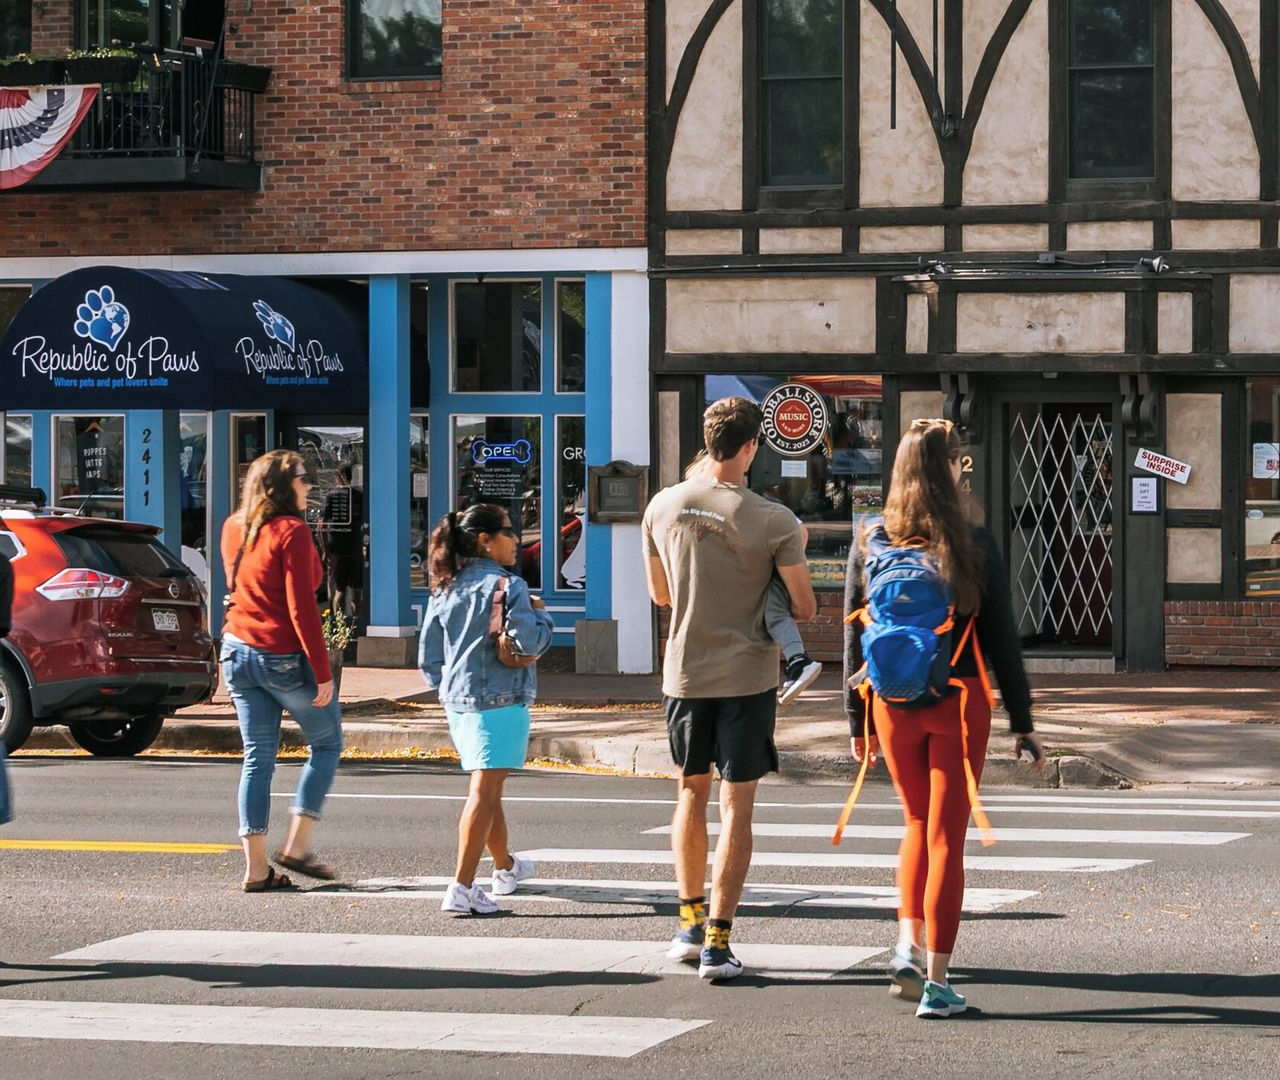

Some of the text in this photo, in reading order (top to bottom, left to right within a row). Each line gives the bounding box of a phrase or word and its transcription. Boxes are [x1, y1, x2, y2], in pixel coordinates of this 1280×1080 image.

[12, 335, 200, 380] Republic of Paws
[235, 337, 344, 379] Republic of Paws
[54, 377, 168, 389] Where pets and pet lovers unite
[779, 413, 809, 421] MUSIC
[776, 438, 792, 449] EST.
[481, 446, 523, 457] OPEN
[1141, 451, 1186, 473] SURPRISE
[1146, 461, 1177, 477] INSIDE
